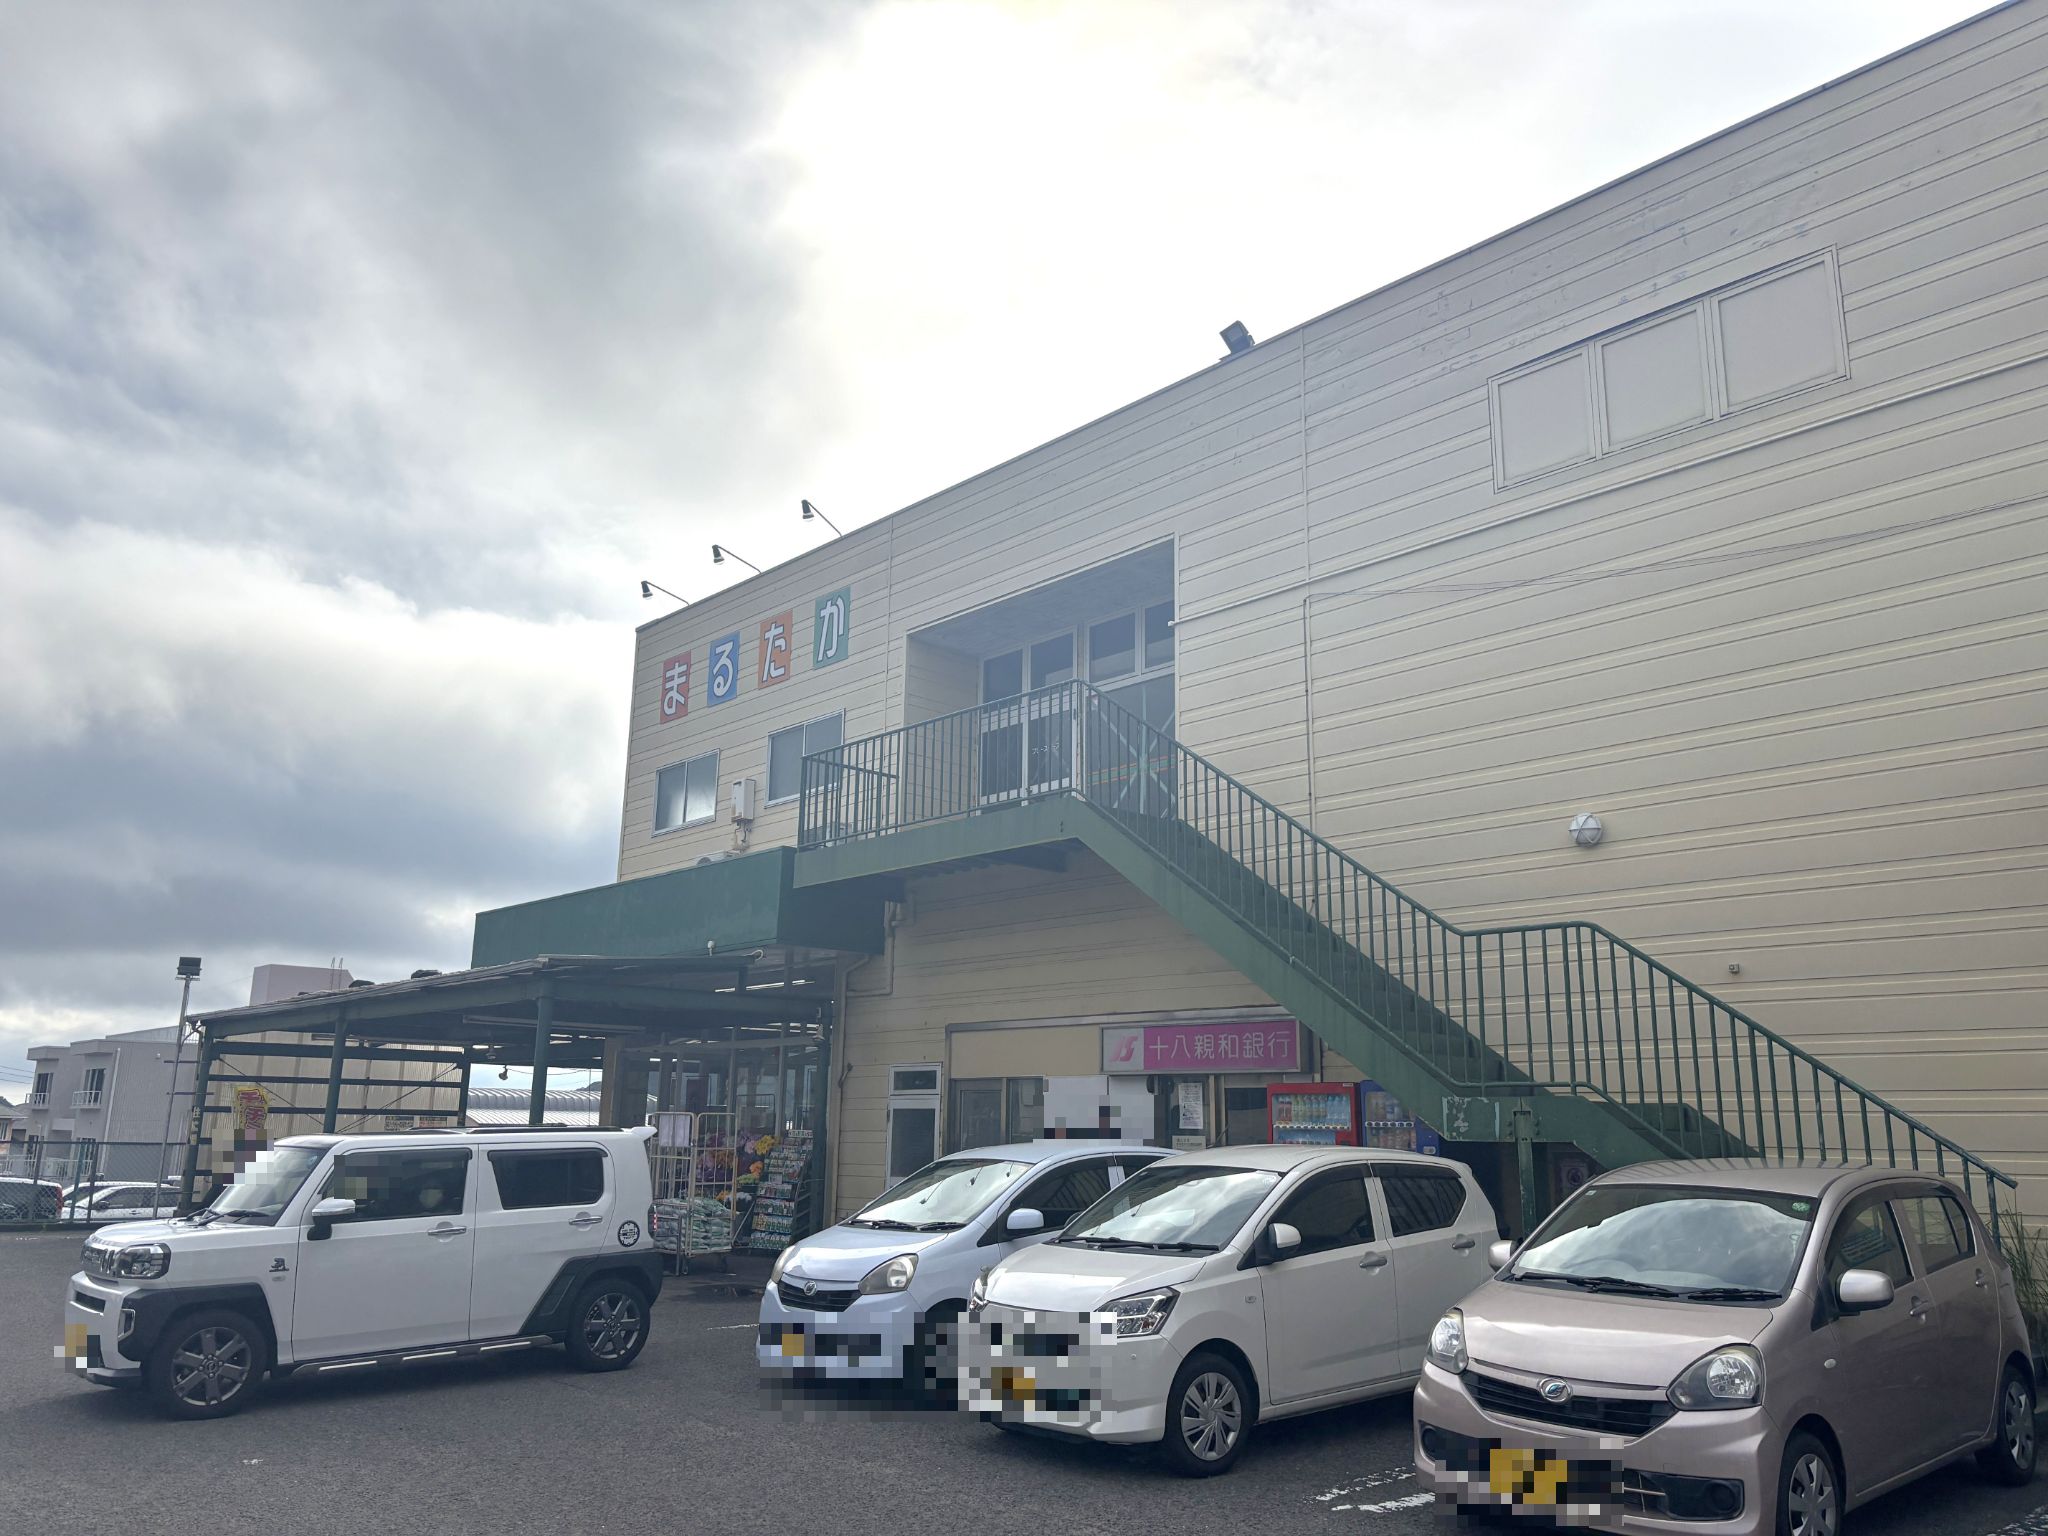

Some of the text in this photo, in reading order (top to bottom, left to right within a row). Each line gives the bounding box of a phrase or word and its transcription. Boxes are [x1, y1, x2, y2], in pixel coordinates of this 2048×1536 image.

[662, 596, 846, 716] まるたか
[1149, 1031, 1291, 1060] 十八親和銀行
